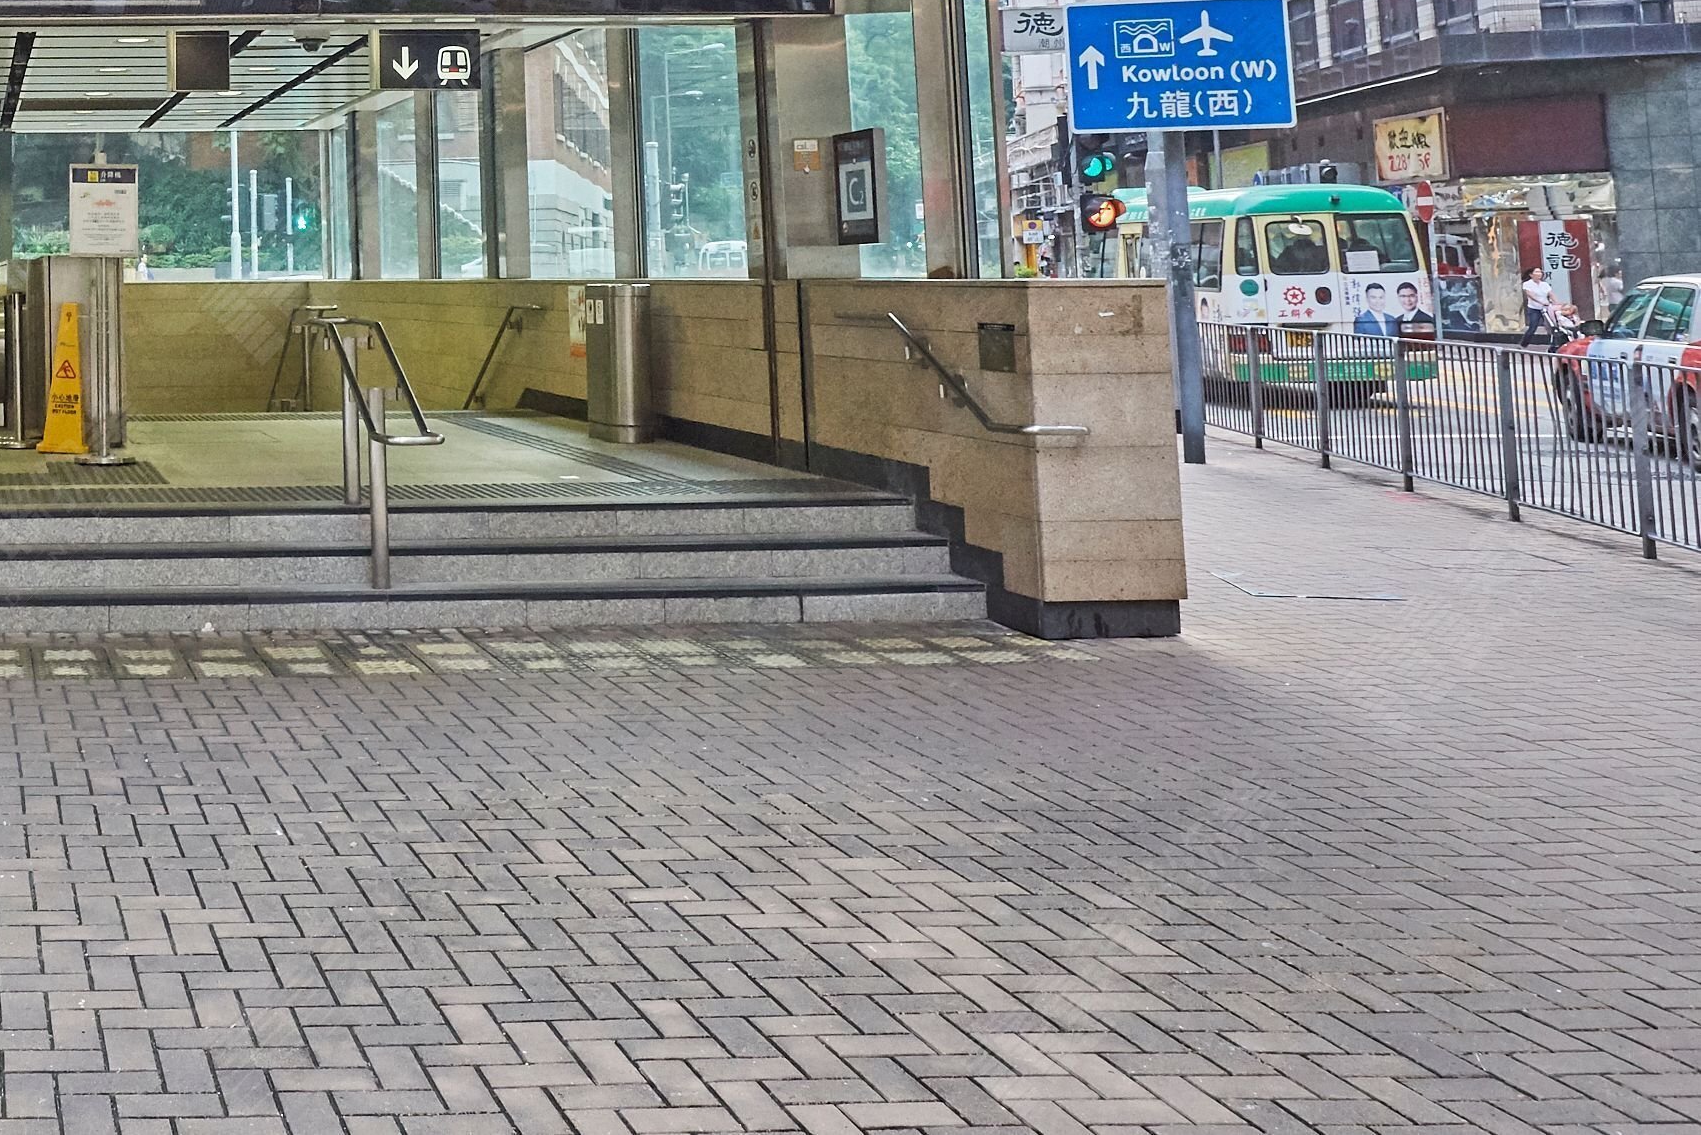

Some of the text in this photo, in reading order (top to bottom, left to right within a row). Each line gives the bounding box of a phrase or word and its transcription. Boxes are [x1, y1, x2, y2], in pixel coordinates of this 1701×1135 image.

[1120, 43, 1171, 54] 西 W
[1122, 59, 1277, 83] Kowloon (W)
[1126, 89, 1253, 120] 九龍(西)
[1544, 232, 1581, 270] 德記
